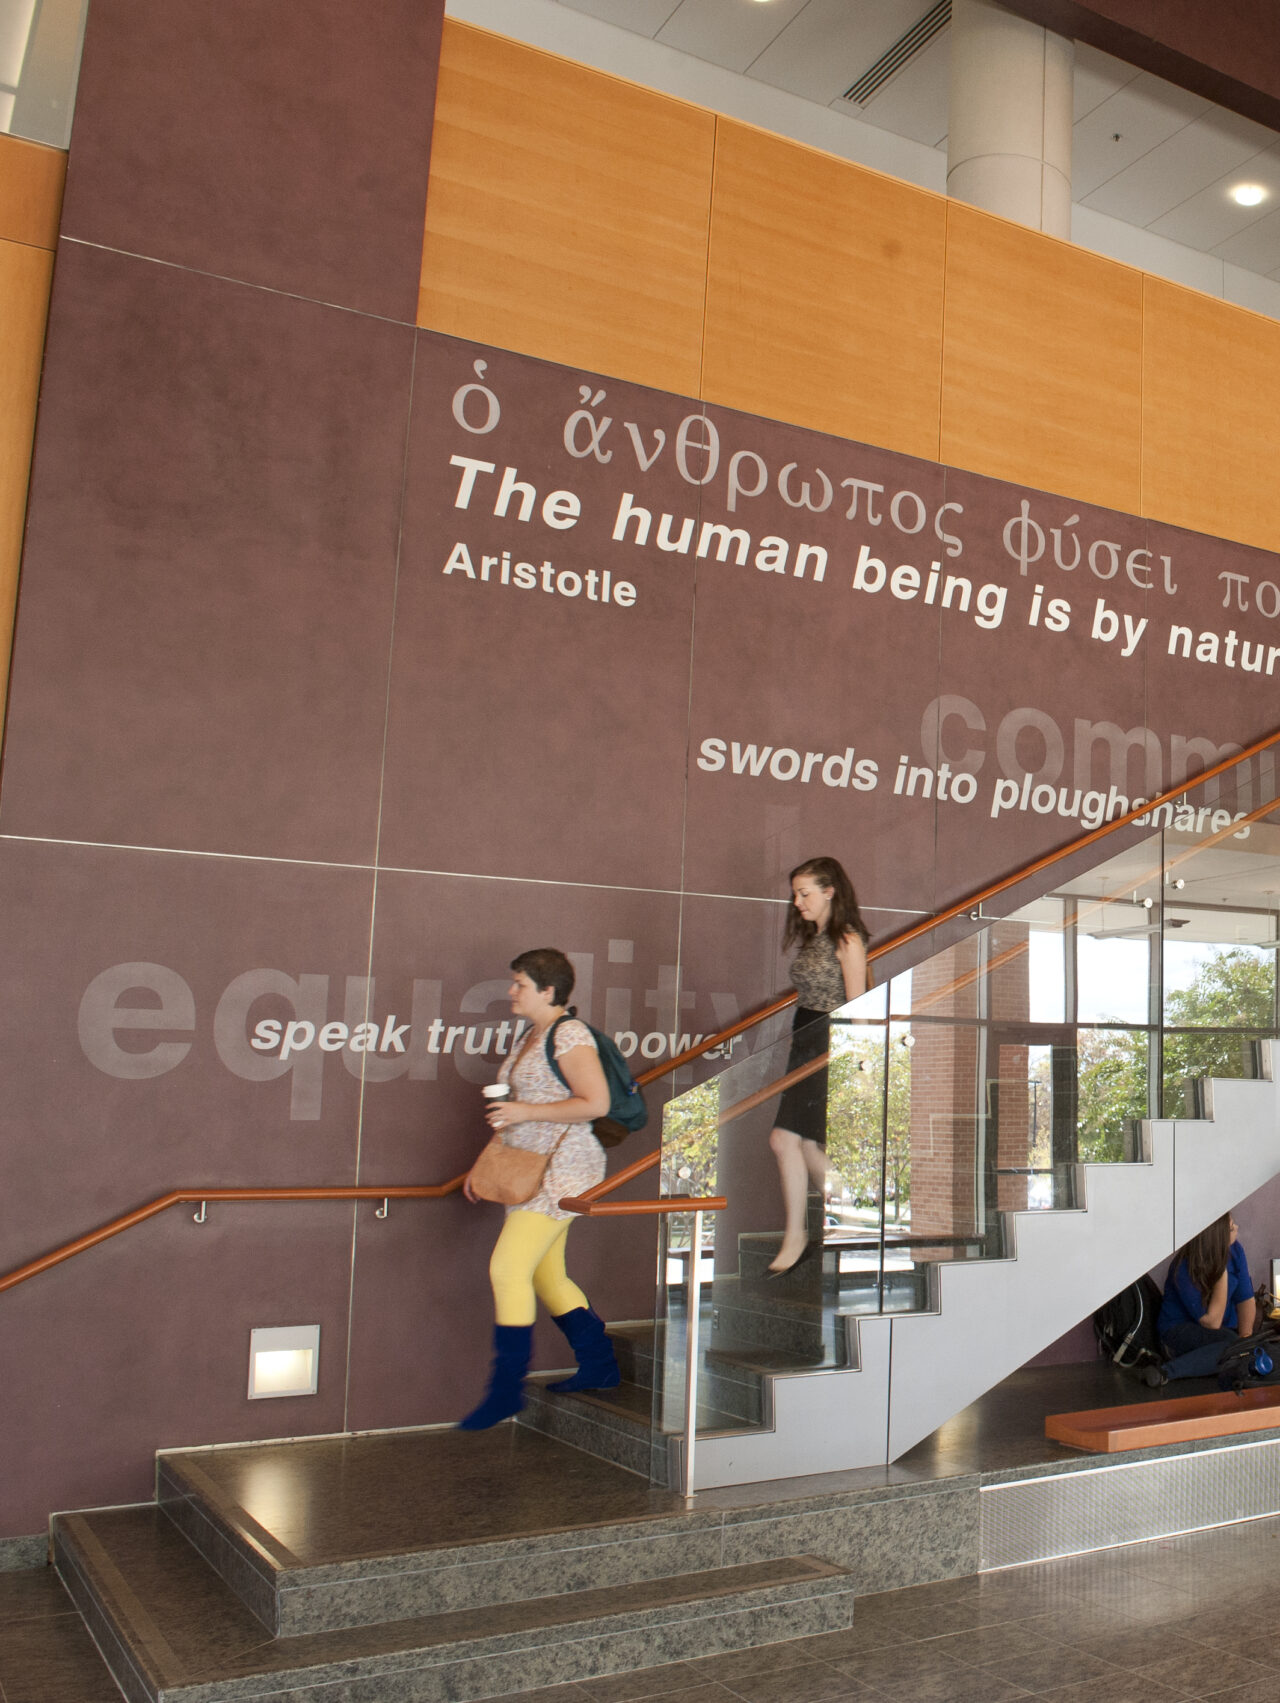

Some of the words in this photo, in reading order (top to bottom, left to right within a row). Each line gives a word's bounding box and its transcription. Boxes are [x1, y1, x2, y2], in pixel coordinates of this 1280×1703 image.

[442, 542, 637, 607] Aristotle
[449, 455, 581, 530] The
[612, 492, 829, 582] human
[852, 545, 1008, 630] being
[1028, 584, 1072, 632] is
[1091, 598, 1149, 657] by
[697, 734, 879, 792] swords
[893, 755, 978, 804] into
[989, 772, 1250, 840] ploughshares
[250, 1014, 411, 1060] speak
